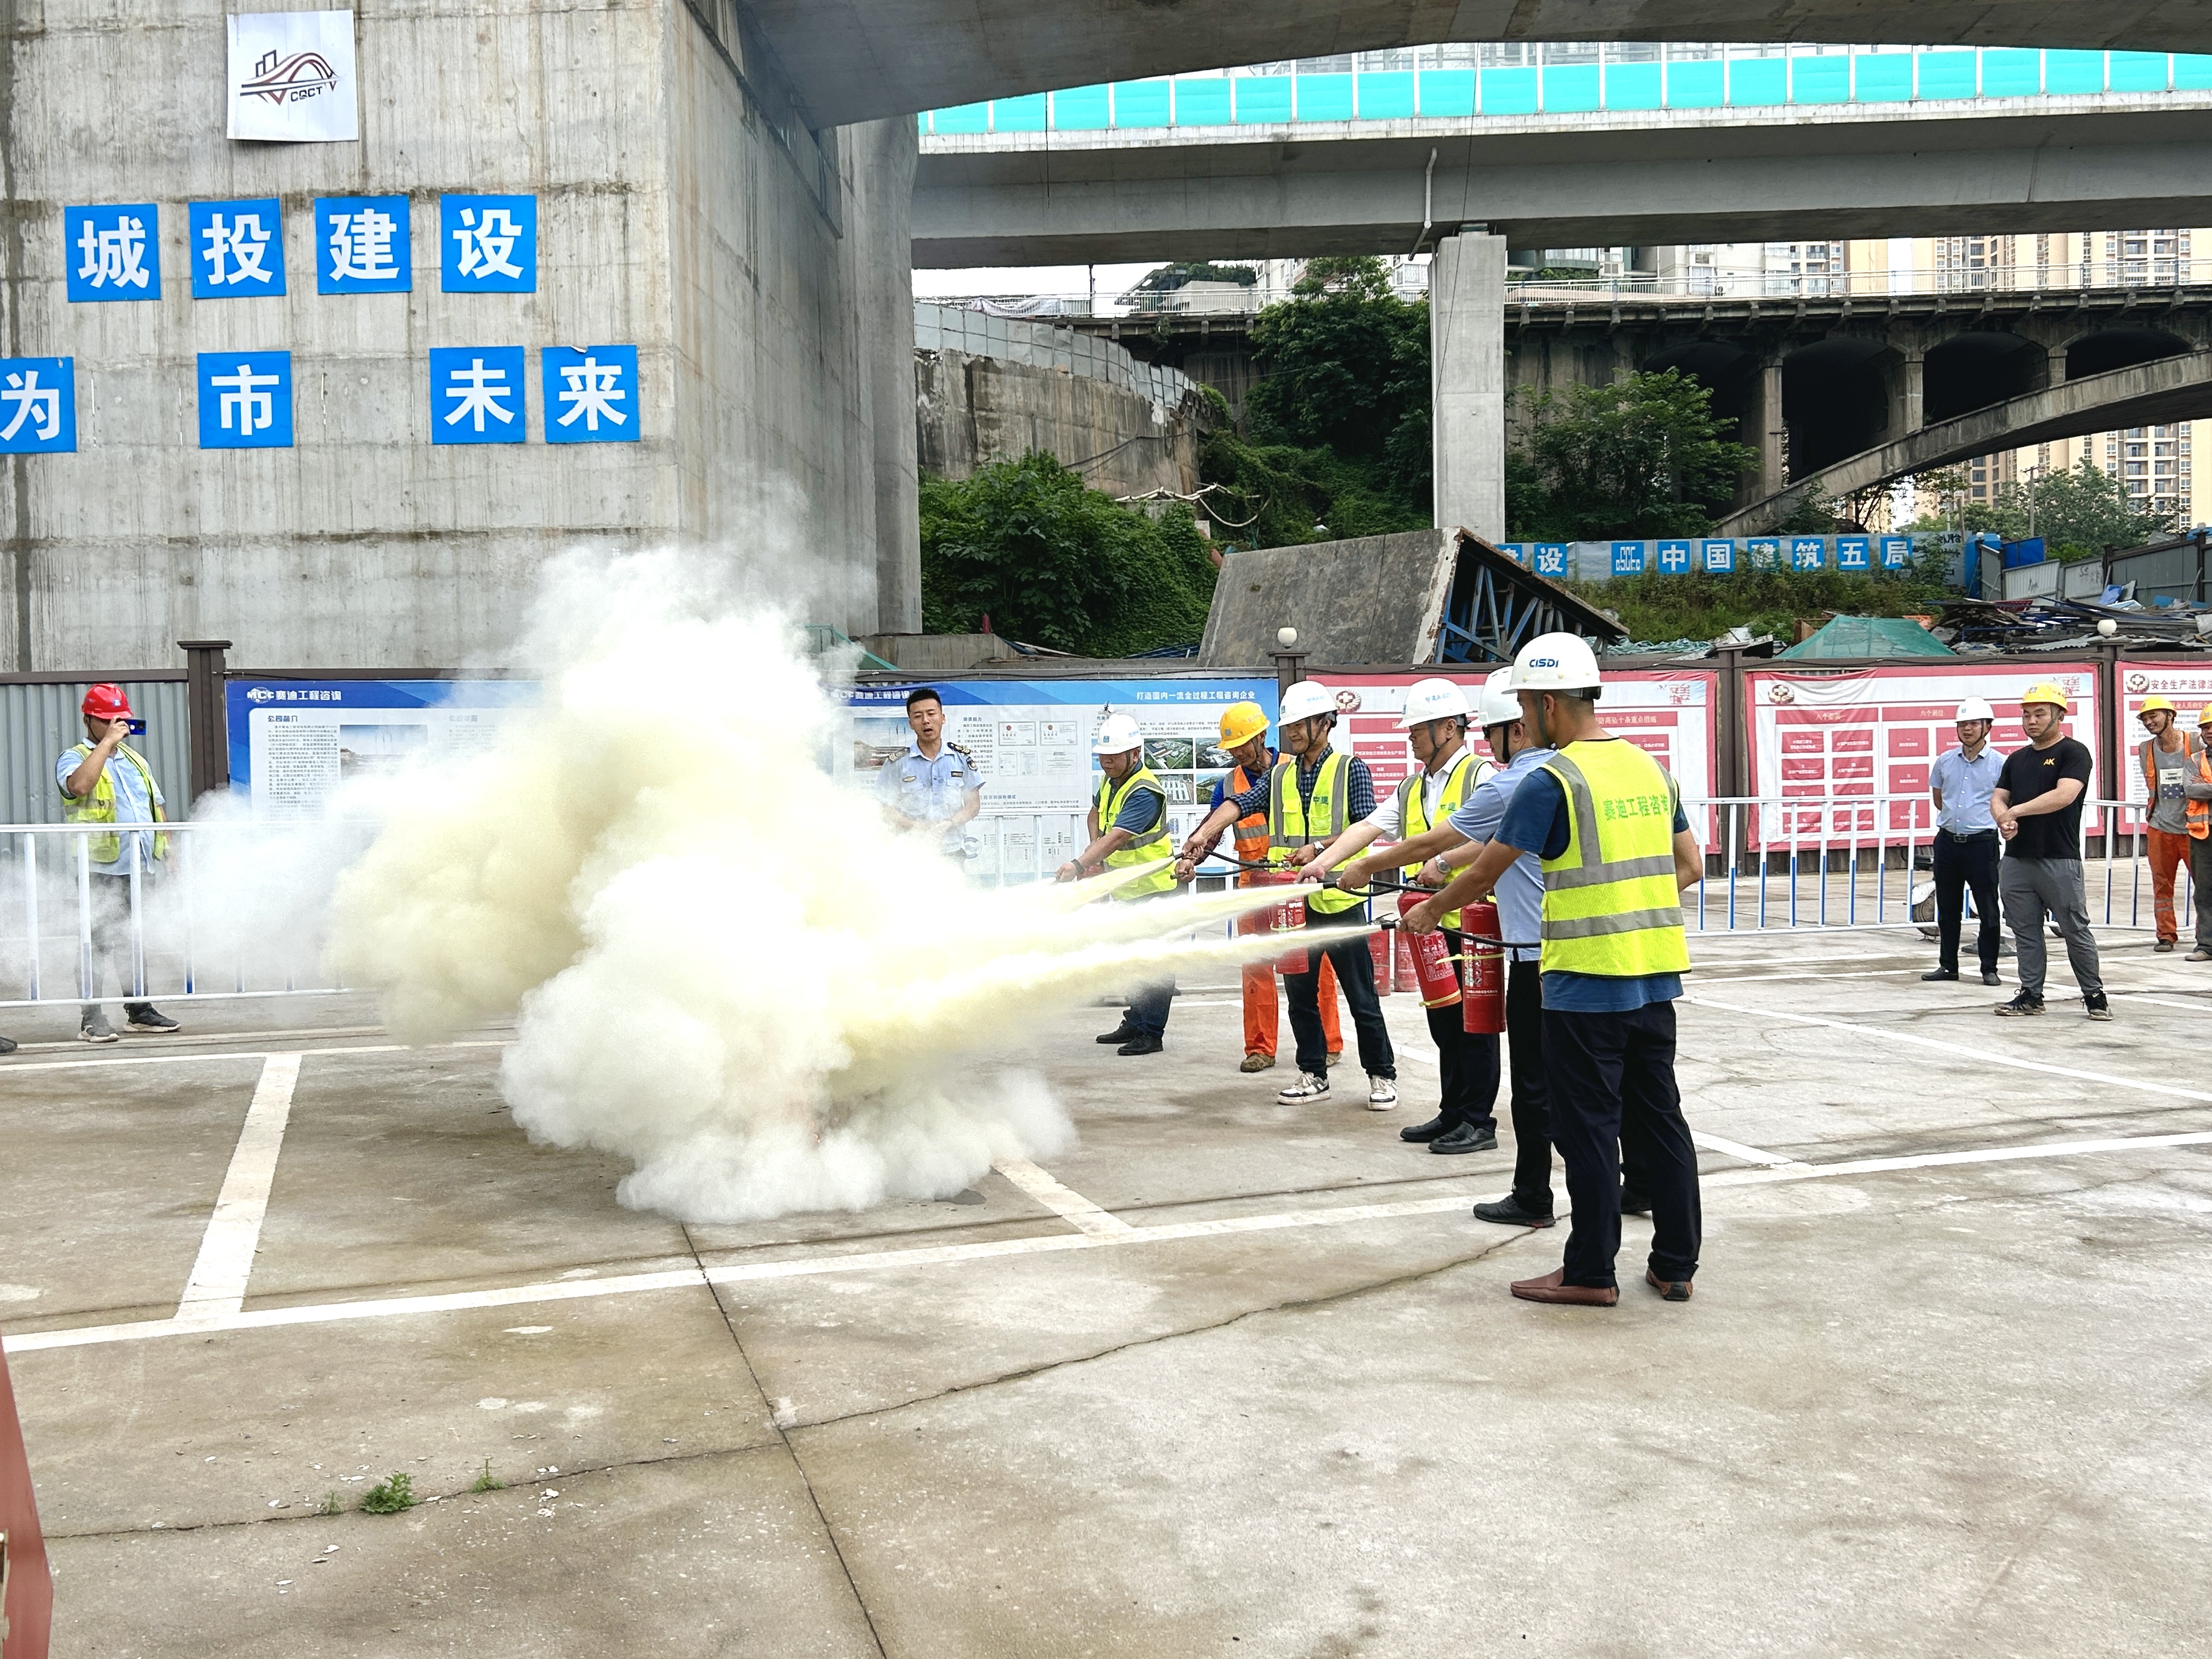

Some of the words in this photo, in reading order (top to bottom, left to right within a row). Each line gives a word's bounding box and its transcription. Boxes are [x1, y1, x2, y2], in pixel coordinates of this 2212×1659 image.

[77, 207, 524, 290] 城投建设
[0, 371, 60, 441] 为
[211, 364, 280, 436] 市
[444, 357, 628, 432] 未来
[1662, 541, 1910, 571] 中国建筑五局
[1529, 658, 1559, 668] CISDI
[275, 690, 342, 701] 赛迪工程咨询
[1136, 691, 1255, 701] 打造国内一流全过程工程咨询企业
[1596, 715, 1657, 725] 防高坠十条重点措施
[2043, 758, 2056, 766] AK
